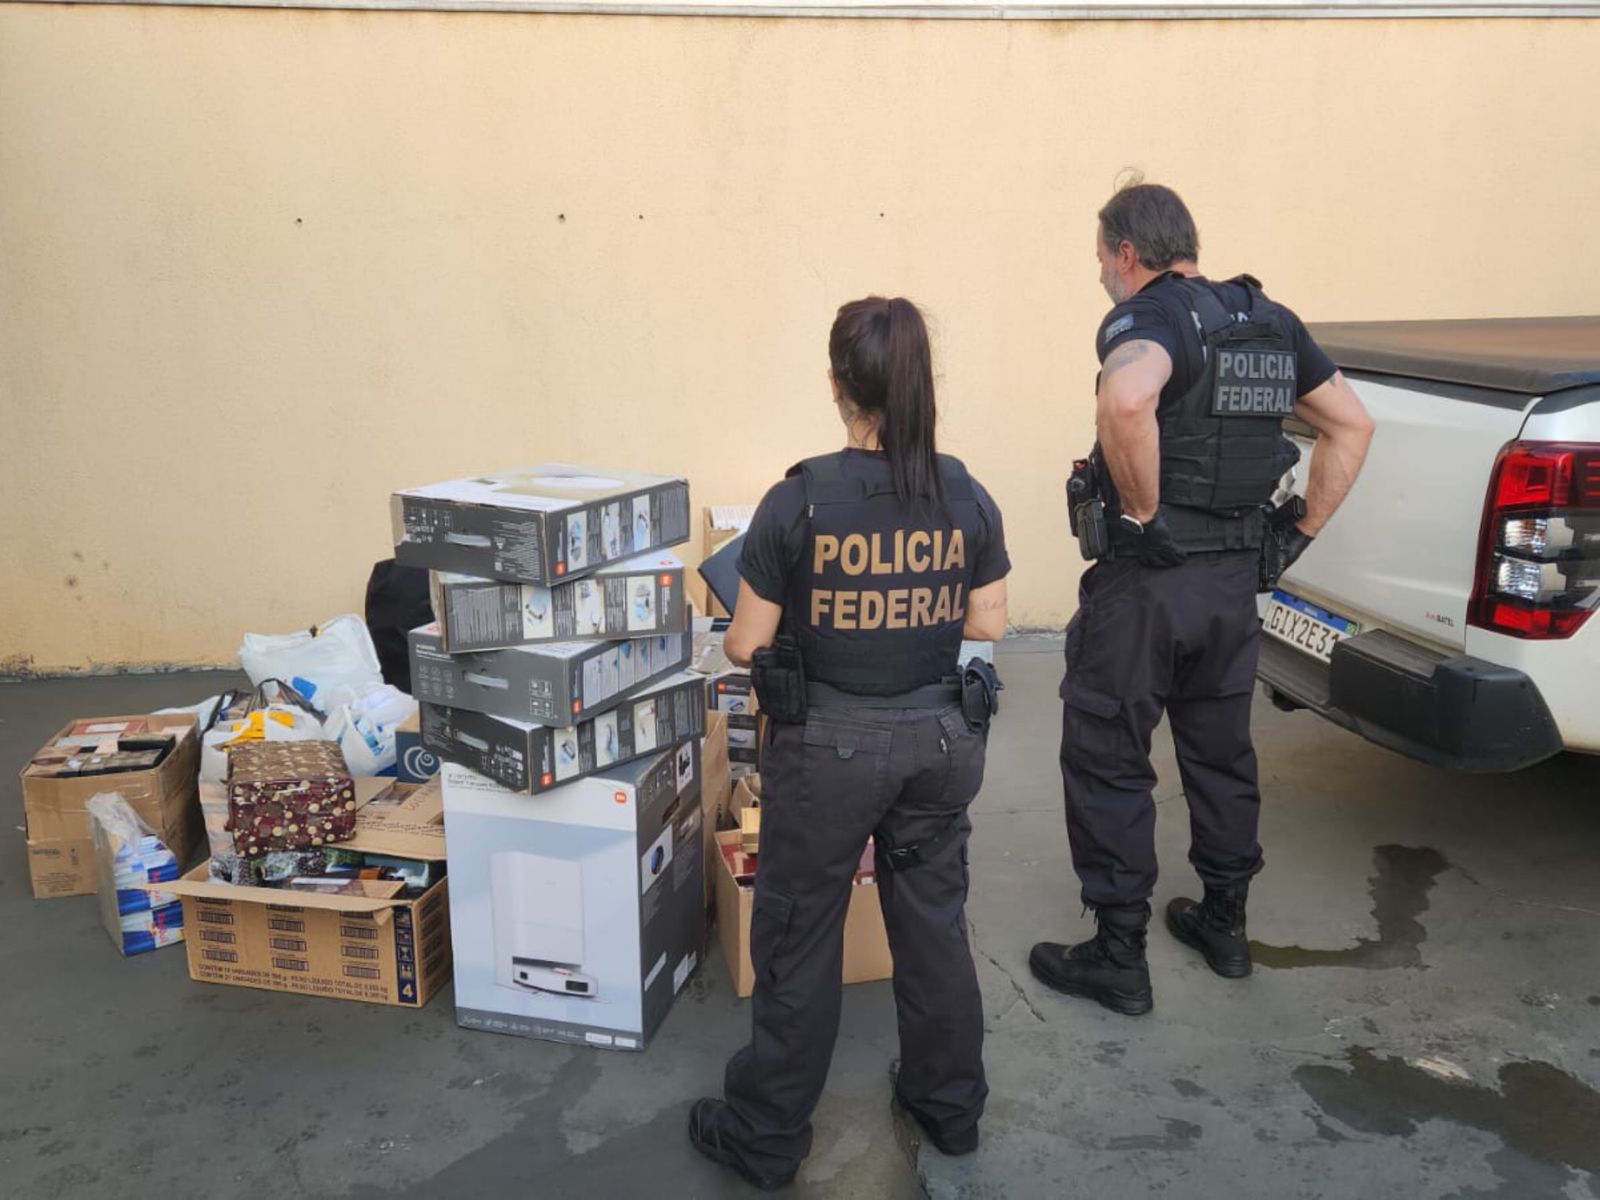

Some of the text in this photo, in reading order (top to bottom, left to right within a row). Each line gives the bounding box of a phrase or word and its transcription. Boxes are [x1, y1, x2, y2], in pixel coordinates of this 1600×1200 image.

[1216, 385, 1293, 413] FEDERAL
[810, 582, 965, 630] FEDERAL
[402, 983, 414, 998] 4
